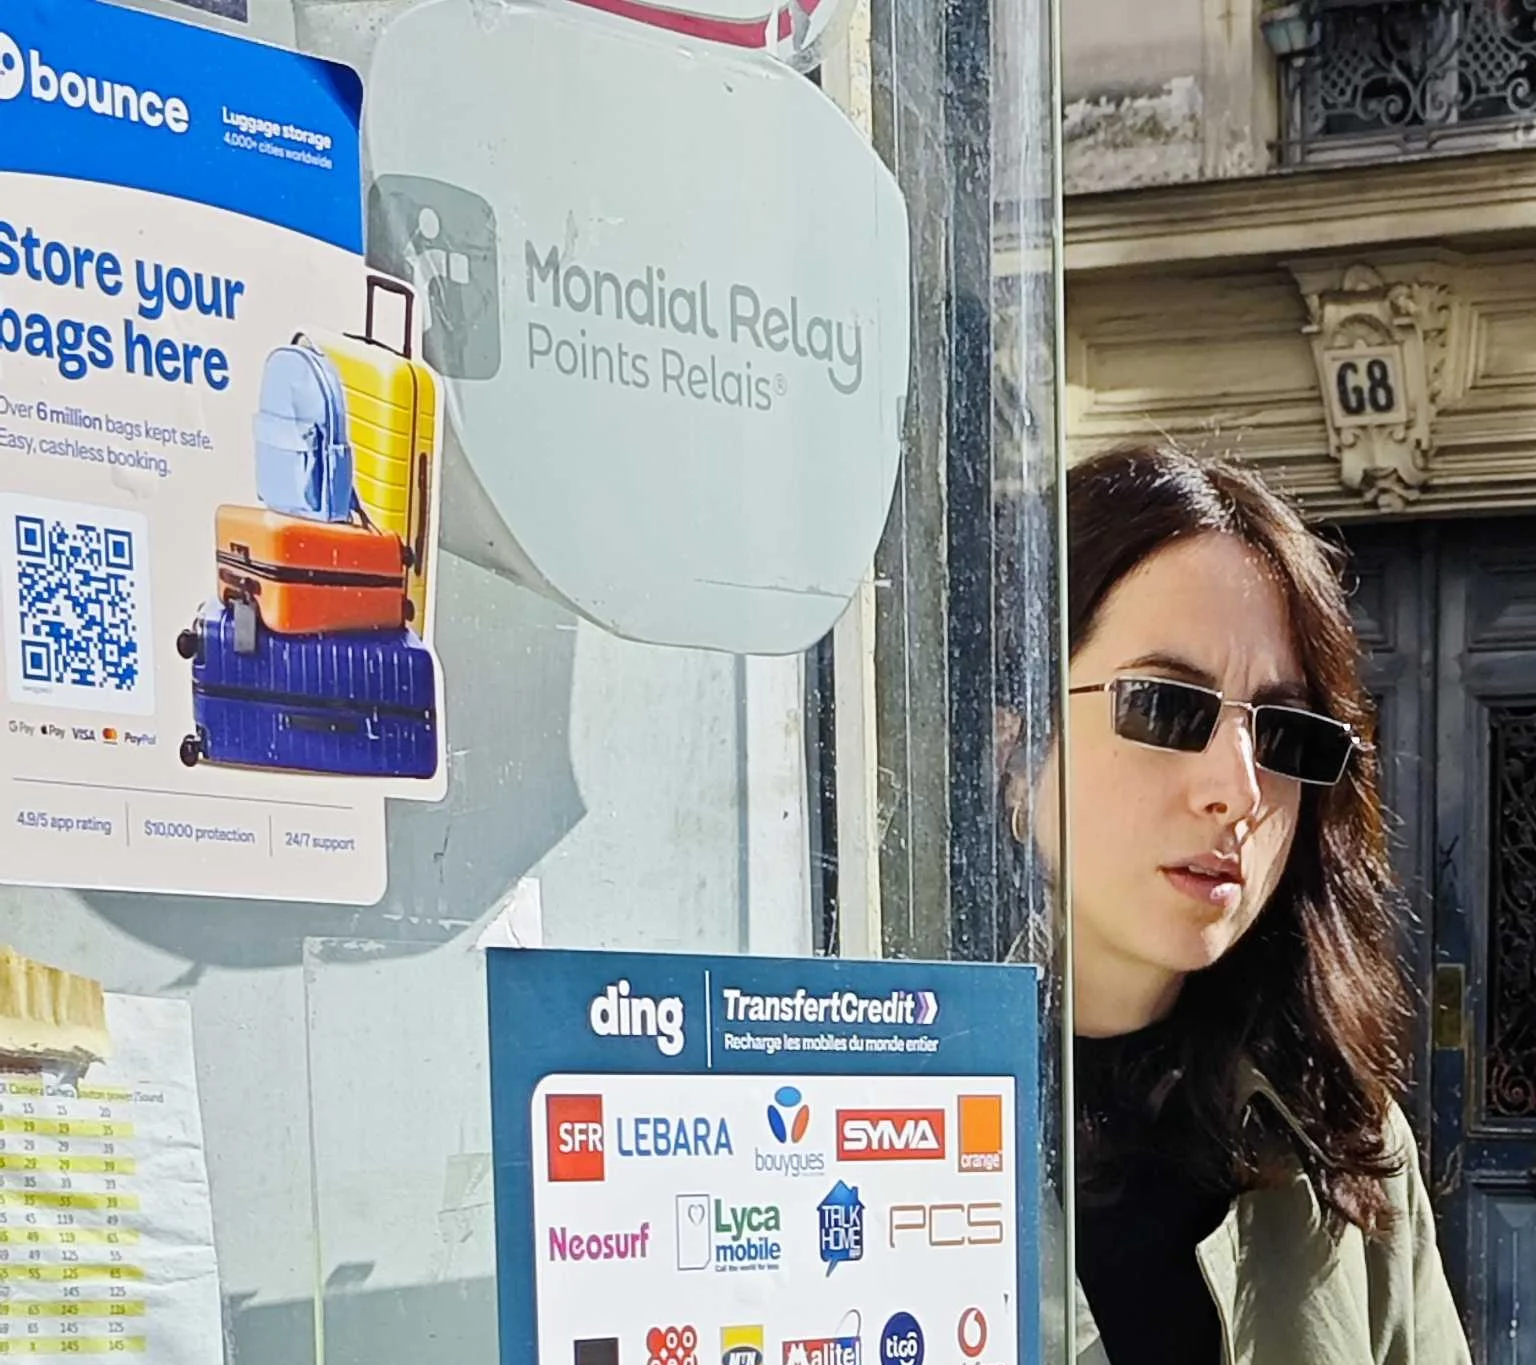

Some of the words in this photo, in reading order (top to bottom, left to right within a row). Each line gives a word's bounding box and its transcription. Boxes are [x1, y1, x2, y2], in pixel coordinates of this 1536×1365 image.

[29, 49, 190, 134] bounce
[222, 105, 281, 138] Luggage
[282, 124, 332, 151] storage
[0, 221, 122, 296] Store
[136, 260, 245, 319] your
[525, 239, 719, 340] Mondial
[730, 285, 863, 396] Relay
[124, 319, 230, 390] here
[528, 322, 651, 390] Points
[36, 401, 49, 421] 6
[50, 406, 102, 432] million
[105, 413, 142, 442] bags
[144, 420, 178, 447] kept
[180, 429, 214, 451] safe.
[39, 436, 104, 463] cashless
[107, 446, 172, 478] booking.
[72, 727, 96, 741] VISA
[124, 731, 157, 746] PayPal
[50, 816, 75, 832] app
[75, 817, 112, 835] rating
[144, 820, 193, 839] $10,000
[195, 826, 256, 844] protection
[285, 832, 310, 848] 24/7
[312, 835, 356, 852] support
[589, 979, 686, 1056] ding
[723, 988, 916, 1025] TransfertCredit
[724, 1033, 782, 1055] Recharge
[784, 1033, 801, 1051] les
[802, 1033, 848, 1052] mobiles
[848, 1035, 865, 1052] du
[865, 1036, 905, 1052] monde
[906, 1036, 939, 1053] entier
[559, 1121, 603, 1154] SFR
[616, 1117, 734, 1157] LEBARA
[842, 1119, 940, 1151] SYMA
[755, 1148, 825, 1177] bouygues
[960, 1151, 1000, 1170] orange
[714, 1198, 781, 1242] Lyca
[821, 1205, 861, 1229] TALK
[889, 1202, 1003, 1249] PCS
[549, 1222, 650, 1262] Neosurf
[715, 1236, 781, 1263] mobile
[821, 1227, 862, 1251] HOME
